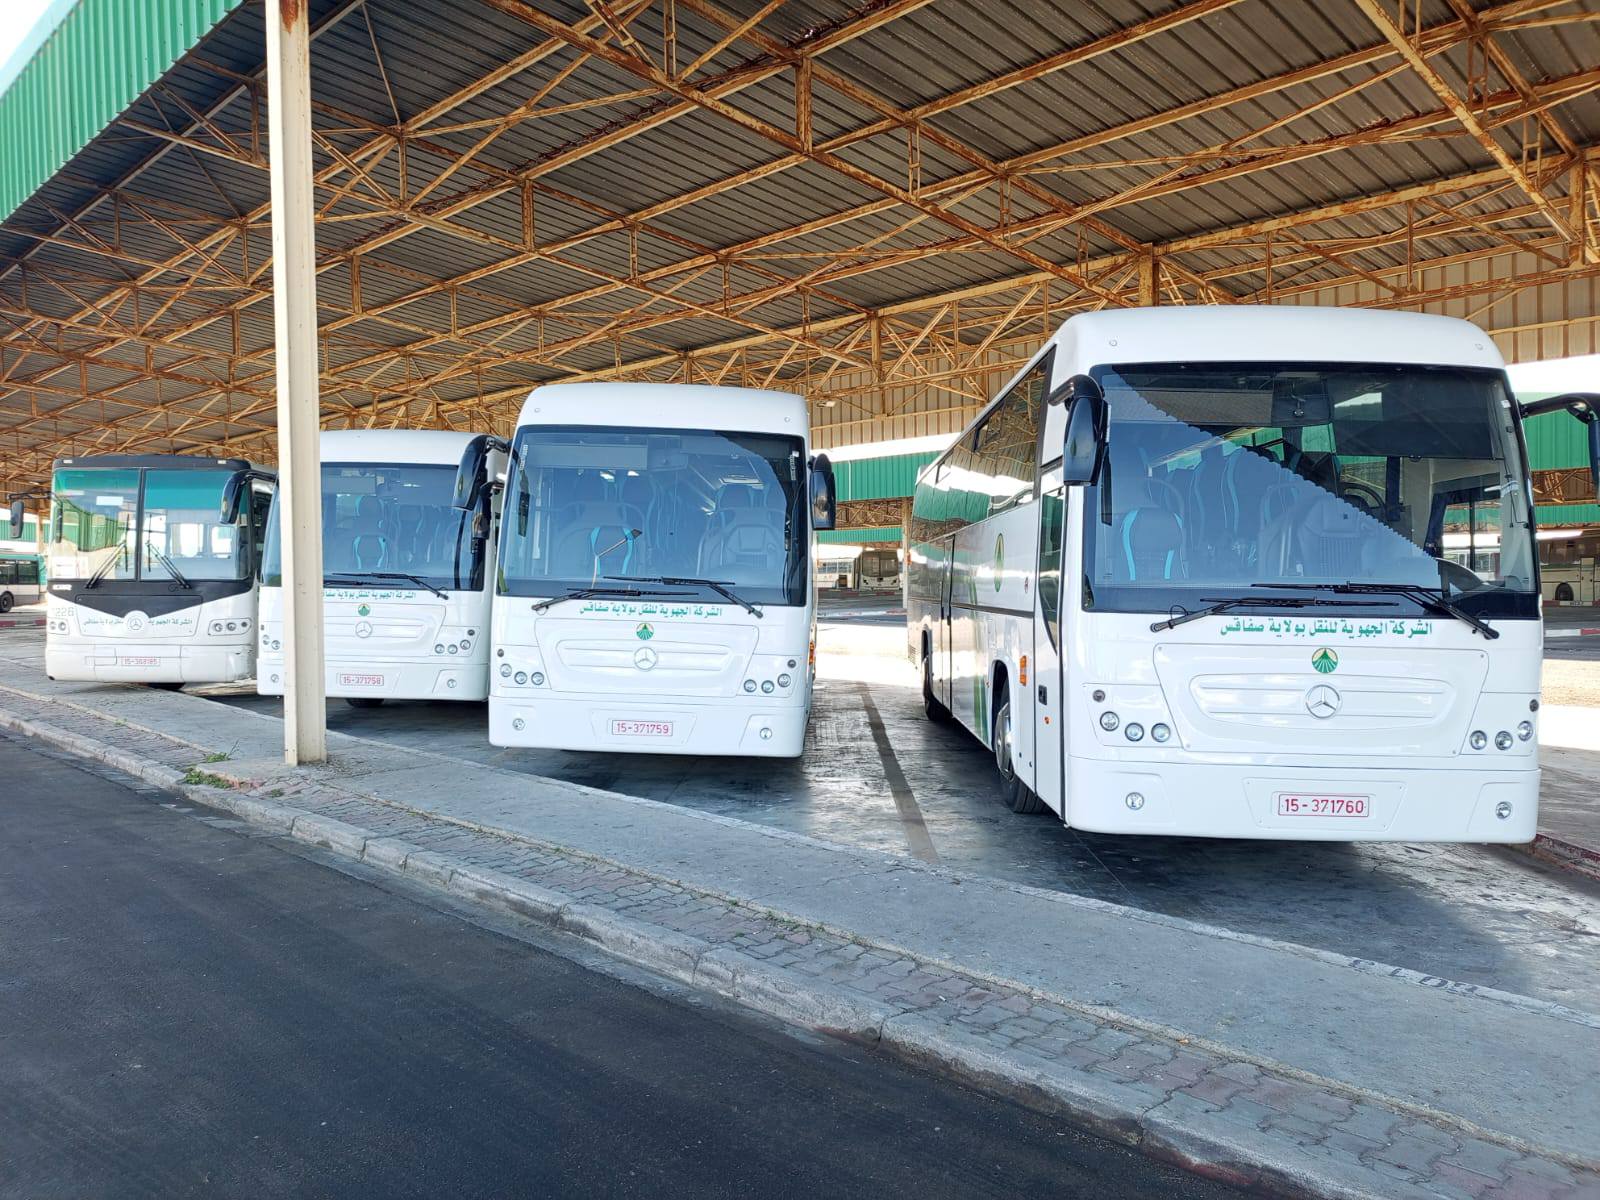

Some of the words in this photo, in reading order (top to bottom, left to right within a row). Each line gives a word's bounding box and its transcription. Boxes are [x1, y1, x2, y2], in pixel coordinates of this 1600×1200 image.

[579, 601, 609, 615] صفاقس
[638, 603, 657, 616] للنقل
[659, 604, 691, 618] الجهوية
[693, 604, 722, 618] الشركة
[1219, 616, 1265, 636] صفاقس
[1268, 617, 1306, 638] بولاية
[1308, 618, 1338, 637] للنقل
[1341, 618, 1388, 639] الجهوية
[1391, 619, 1433, 638] الشركة
[616, 722, 670, 734] 15-371759
[1284, 798, 1365, 814] 15-371760
